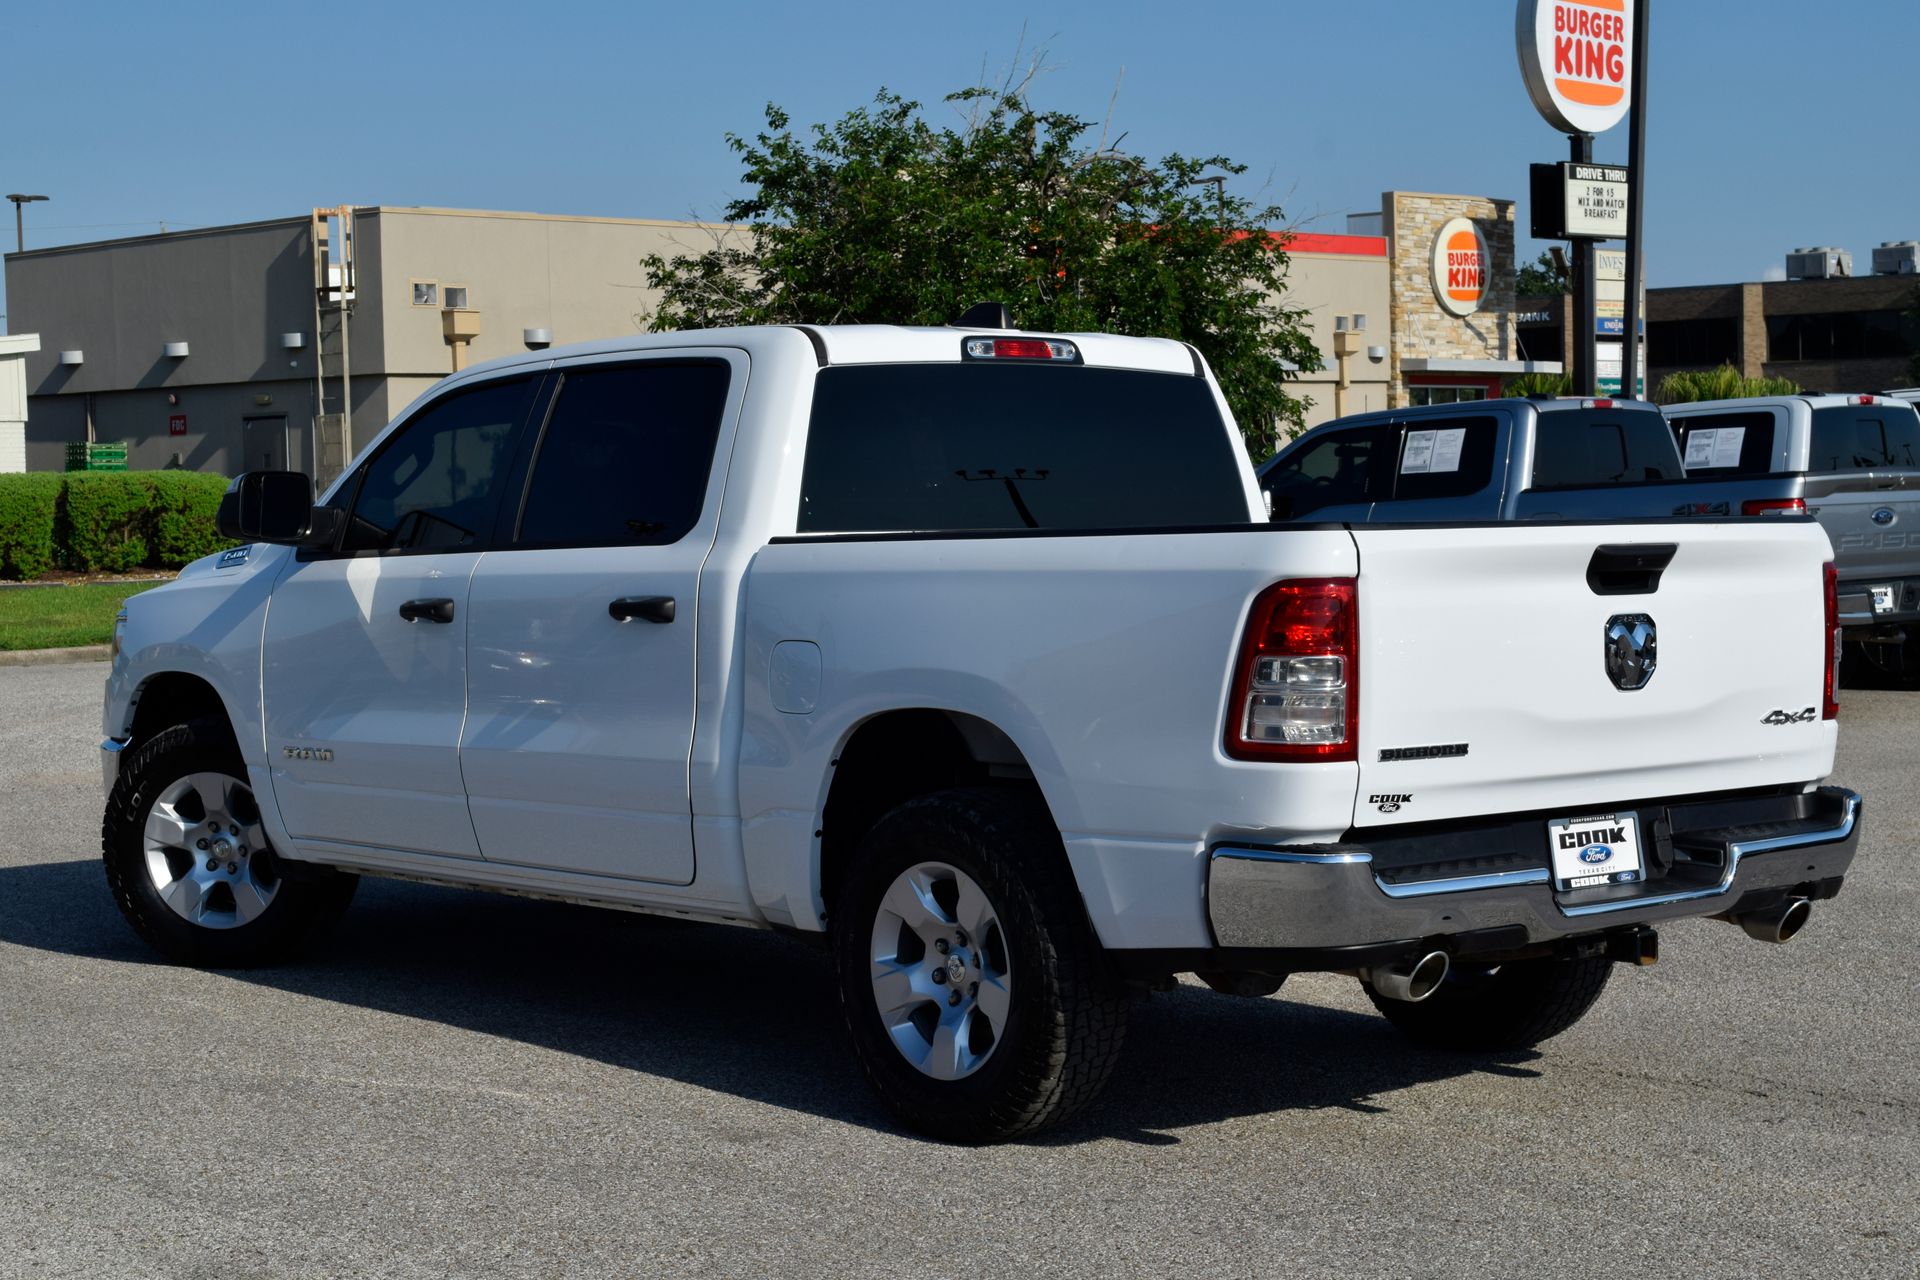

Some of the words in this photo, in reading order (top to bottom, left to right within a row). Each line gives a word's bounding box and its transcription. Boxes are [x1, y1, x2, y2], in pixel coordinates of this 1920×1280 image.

[1555, 5, 1624, 43] BURGER
[1555, 35, 1624, 83] KING
[1576, 167, 1603, 180] DRIVE
[1604, 169, 1627, 182] THRU
[1593, 187, 1603, 196] FOR
[1578, 197, 1590, 207] MIX
[1593, 199, 1604, 207] AND
[1605, 200, 1625, 209] MATCH
[1584, 209, 1618, 219] BREAKFAST
[1447, 252, 1486, 267] BURGER
[1448, 268, 1486, 288] KING
[1516, 311, 1551, 322] BANK
[283, 746, 335, 761] RAM
[1378, 743, 1469, 762] BIGHORN
[1369, 794, 1413, 803] COOK
[1559, 827, 1627, 849] COOK
[1586, 848, 1606, 861] Ford
[1571, 875, 1611, 888] COOK
